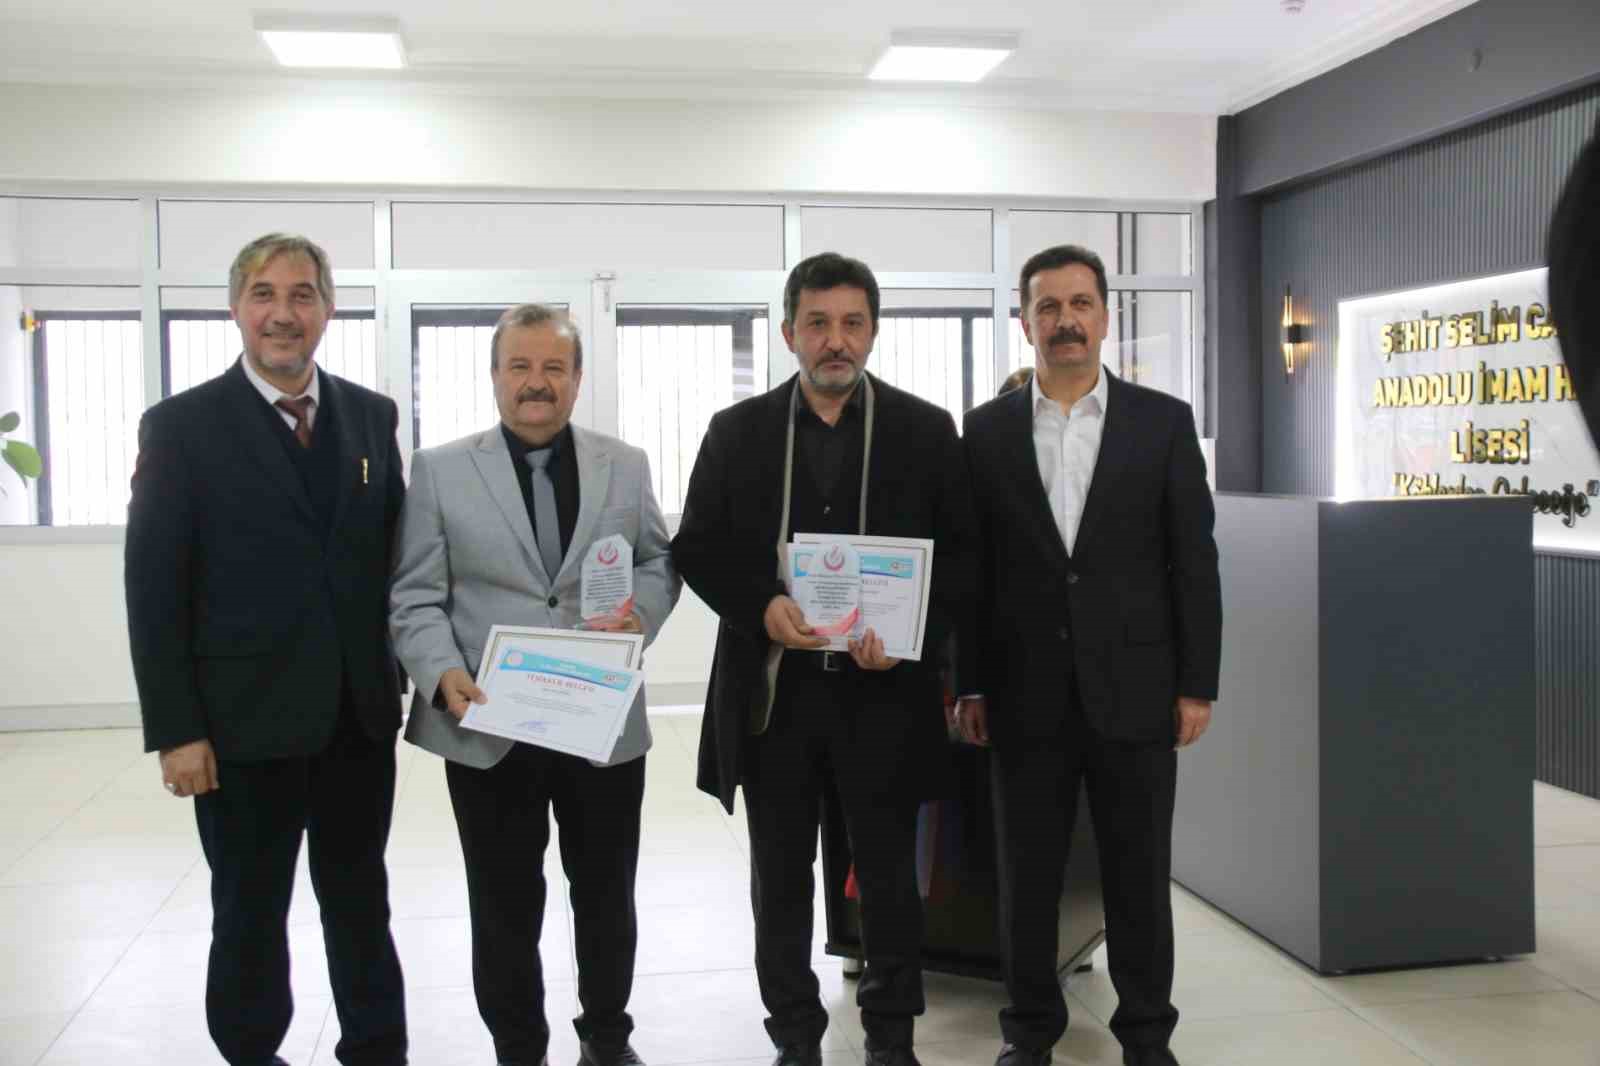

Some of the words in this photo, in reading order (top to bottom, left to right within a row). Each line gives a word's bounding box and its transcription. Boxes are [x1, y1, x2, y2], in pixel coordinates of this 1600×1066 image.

[1380, 310, 1443, 362] ŞEHİT
[1444, 300, 1520, 347] SELİM
[1374, 369, 1473, 407] ANADOLU
[1477, 361, 1549, 404] İMAM
[1553, 363, 1577, 402] H
[1451, 418, 1530, 464] LİSESİ
